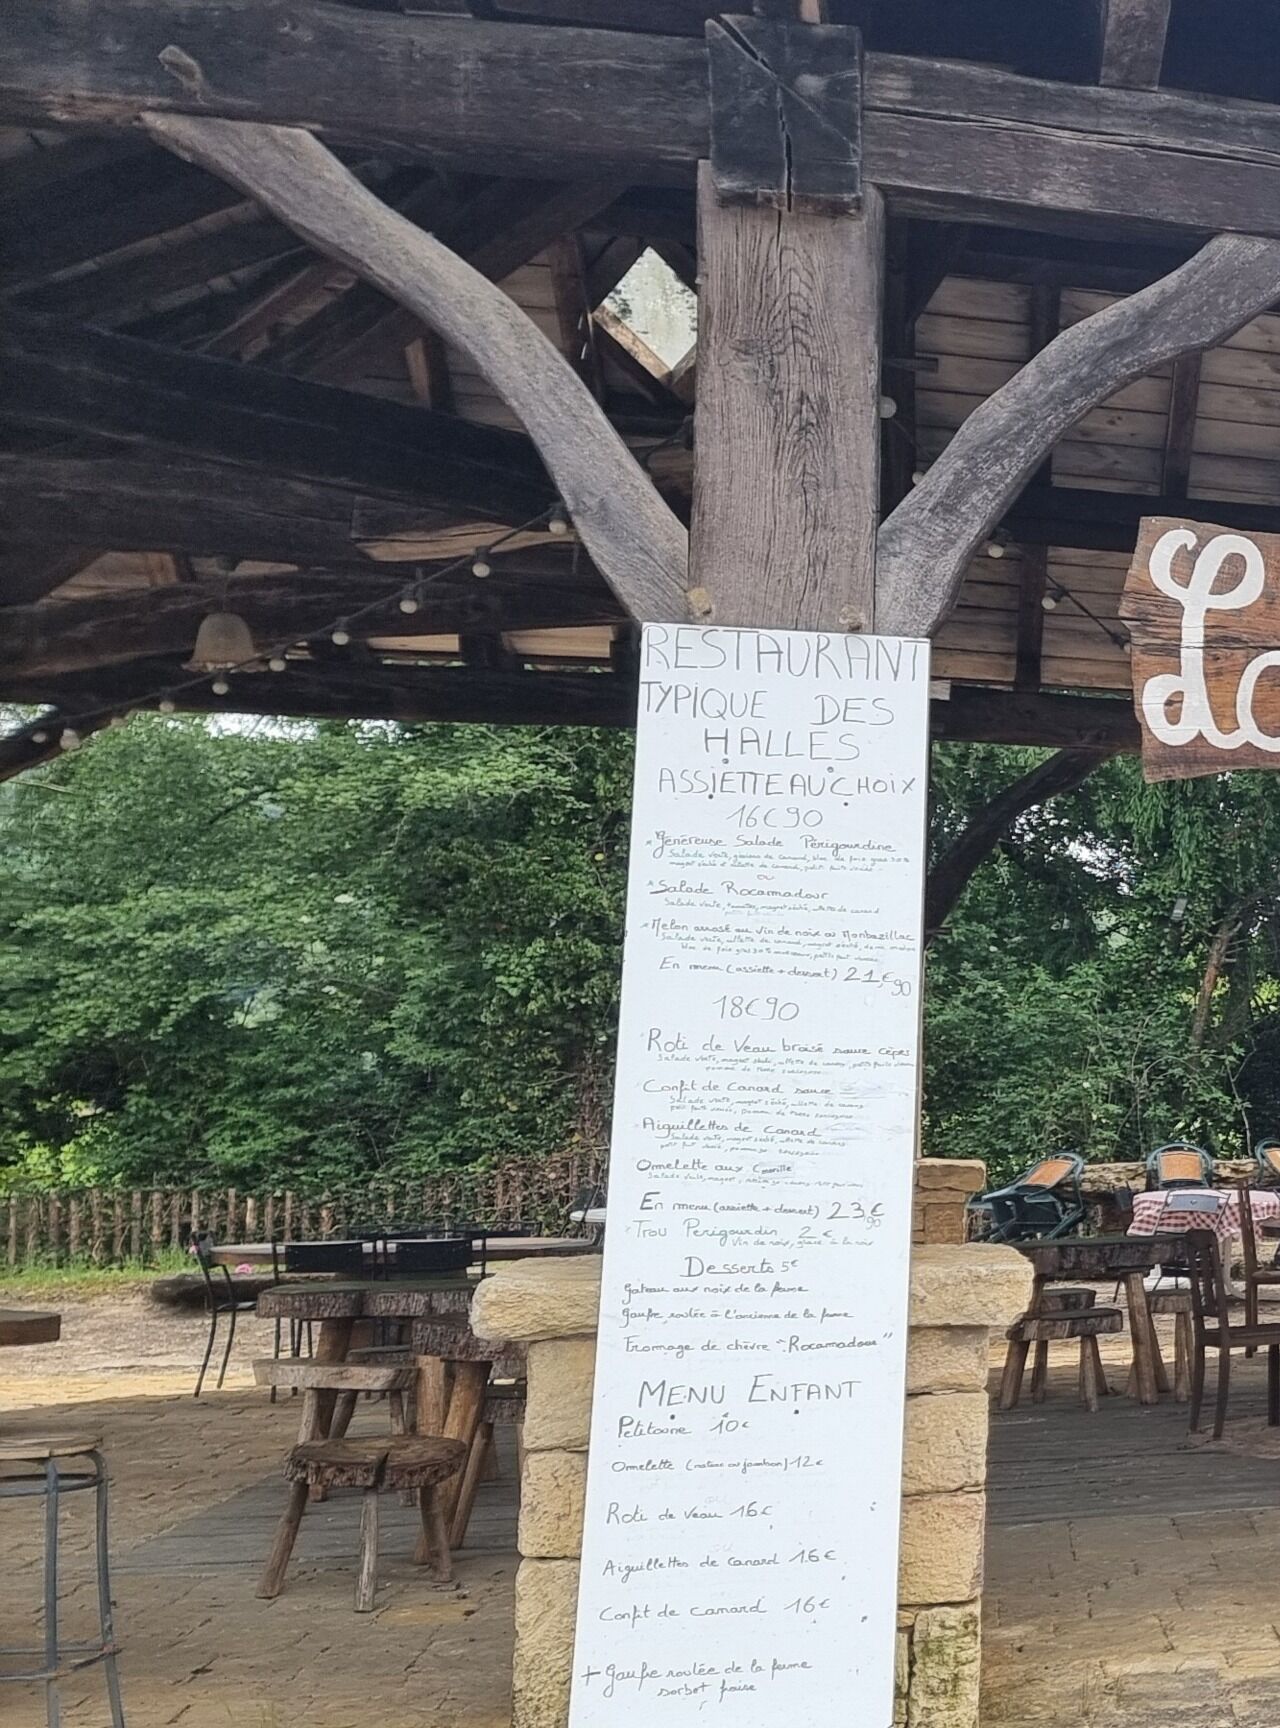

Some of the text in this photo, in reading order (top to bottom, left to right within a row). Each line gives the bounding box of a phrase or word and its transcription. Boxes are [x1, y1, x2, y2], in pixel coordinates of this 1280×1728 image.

[643, 625, 928, 681] RESTAURANT
[810, 694, 895, 726] DES
[704, 727, 860, 761] HALLES
[734, 835, 784, 847] Salade
[800, 835, 896, 857] Périgourdine
[650, 880, 829, 899] Salade Rocamadour
[652, 917, 689, 937] Melon
[777, 926, 792, 936] de
[842, 930, 915, 941] Monbazillac
[659, 956, 680, 970] En
[702, 1034, 726, 1051] de
[734, 1034, 777, 1053] Veau
[643, 1080, 697, 1099] Confit
[702, 1080, 721, 1091] de
[643, 1117, 728, 1138] Aiguillettes
[734, 1122, 752, 1132] de
[637, 1159, 708, 1171] Omelette
[715, 1164, 743, 1172] aux
[640, 1192, 663, 1210] En
[673, 1202, 711, 1210] menu
[632, 1220, 667, 1238] Trou
[680, 1257, 774, 1277] Desserts
[703, 1281, 731, 1294] noix
[734, 1282, 750, 1293] de
[754, 1281, 767, 1293] la
[770, 1281, 809, 1297] ferme
[784, 1309, 799, 1319] de
[802, 1307, 816, 1319] la
[819, 1307, 855, 1324] ferme
[624, 1334, 695, 1359] Fromage
[701, 1340, 720, 1351] de
[726, 1339, 770, 1351] chèvre
[638, 1379, 726, 1408] MENU
[611, 1459, 675, 1472] Omelette
[606, 1502, 648, 1525] Roti
[658, 1506, 676, 1520] de
[602, 1558, 689, 1583] Aiguillettes
[699, 1554, 719, 1568] de
[599, 1604, 650, 1629] Confit
[657, 1604, 680, 1617] de
[665, 1662, 721, 1679] roulée
[724, 1661, 744, 1676] de
[750, 1658, 766, 1673] la
[770, 1658, 813, 1681] ferme
[657, 1682, 712, 1697] sorbet
